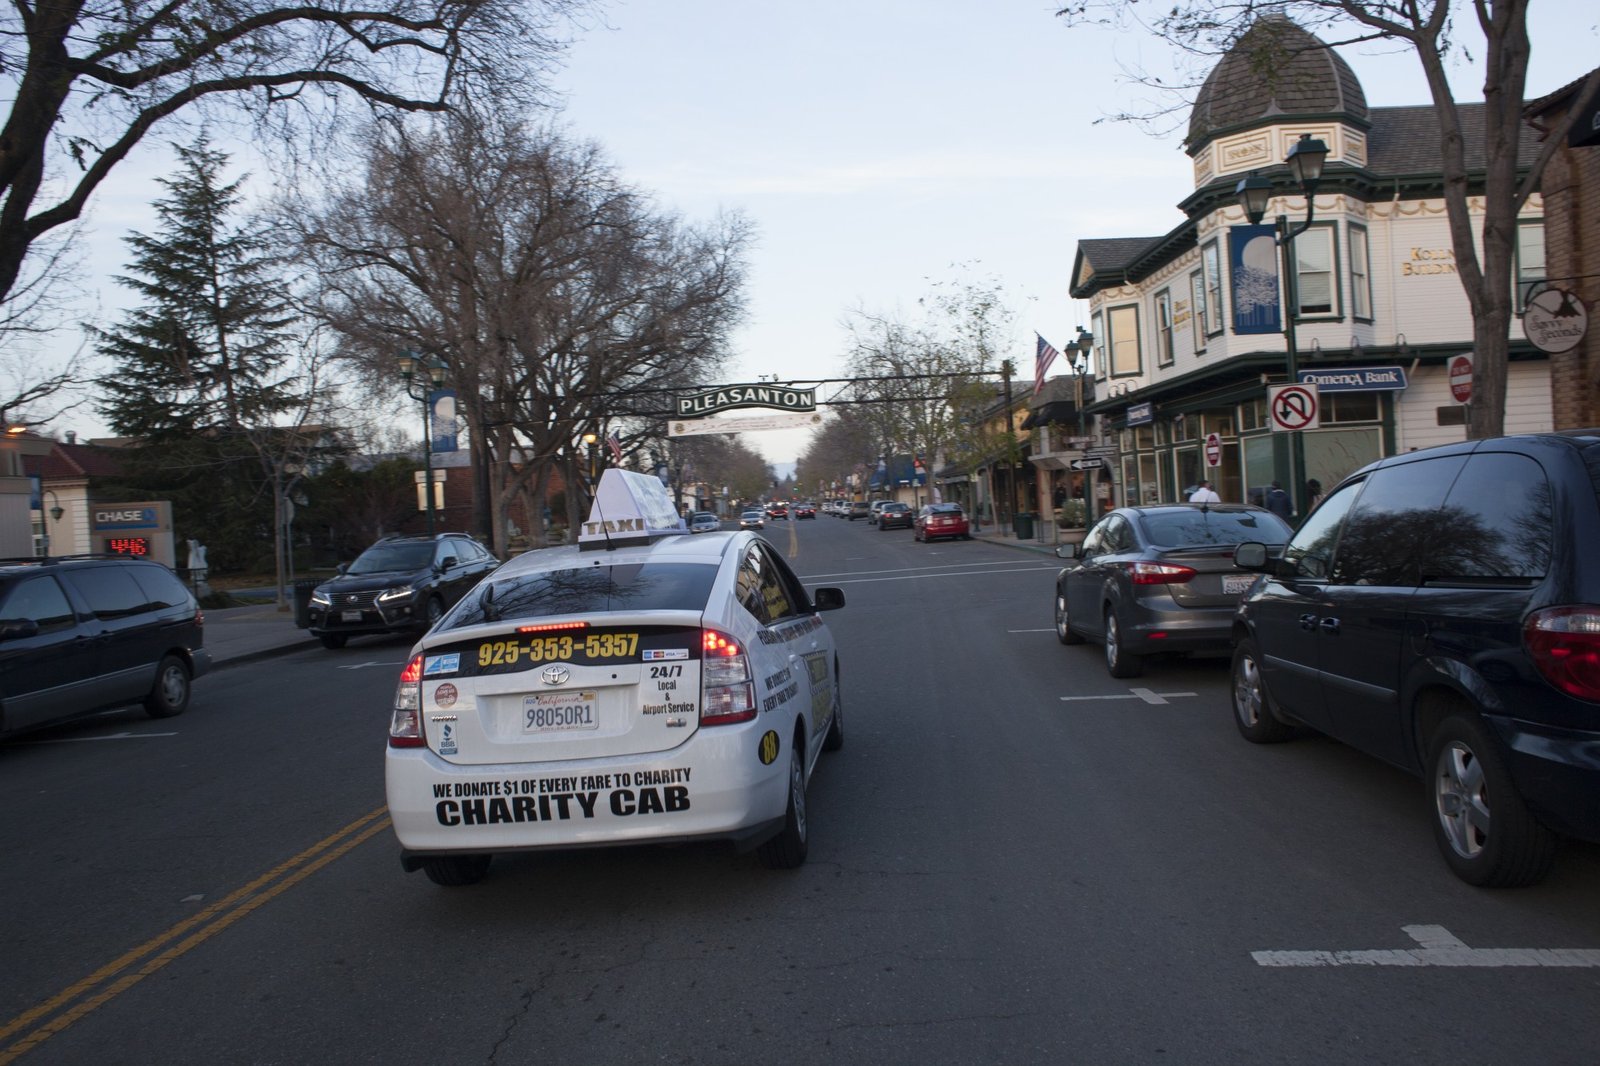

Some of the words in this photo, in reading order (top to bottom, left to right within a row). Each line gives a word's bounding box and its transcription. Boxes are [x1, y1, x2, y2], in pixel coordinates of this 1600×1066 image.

[1365, 372, 1398, 383] Bank
[680, 388, 812, 413] PLEASANTON
[95, 510, 143, 522] CHASE
[583, 518, 644, 535] TAXI
[478, 633, 639, 667] 925-353-5357
[650, 665, 683, 679] 24/7
[658, 680, 676, 691] Local
[537, 695, 580, 706] California
[665, 692, 670, 701] &
[643, 704, 666, 716] Airport
[668, 702, 695, 713] Service
[526, 705, 593, 729] 98050R1
[763, 731, 777, 764] 88
[433, 784, 452, 798] WE
[454, 781, 501, 797] DONATE
[503, 780, 518, 795] $1
[521, 780, 537, 795] OF
[539, 777, 578, 793] EVERY
[581, 775, 612, 790] FARE
[614, 773, 631, 788] TO
[634, 767, 692, 786] CHARITY
[436, 791, 599, 826] CHARITY
[609, 785, 691, 817] CAB
